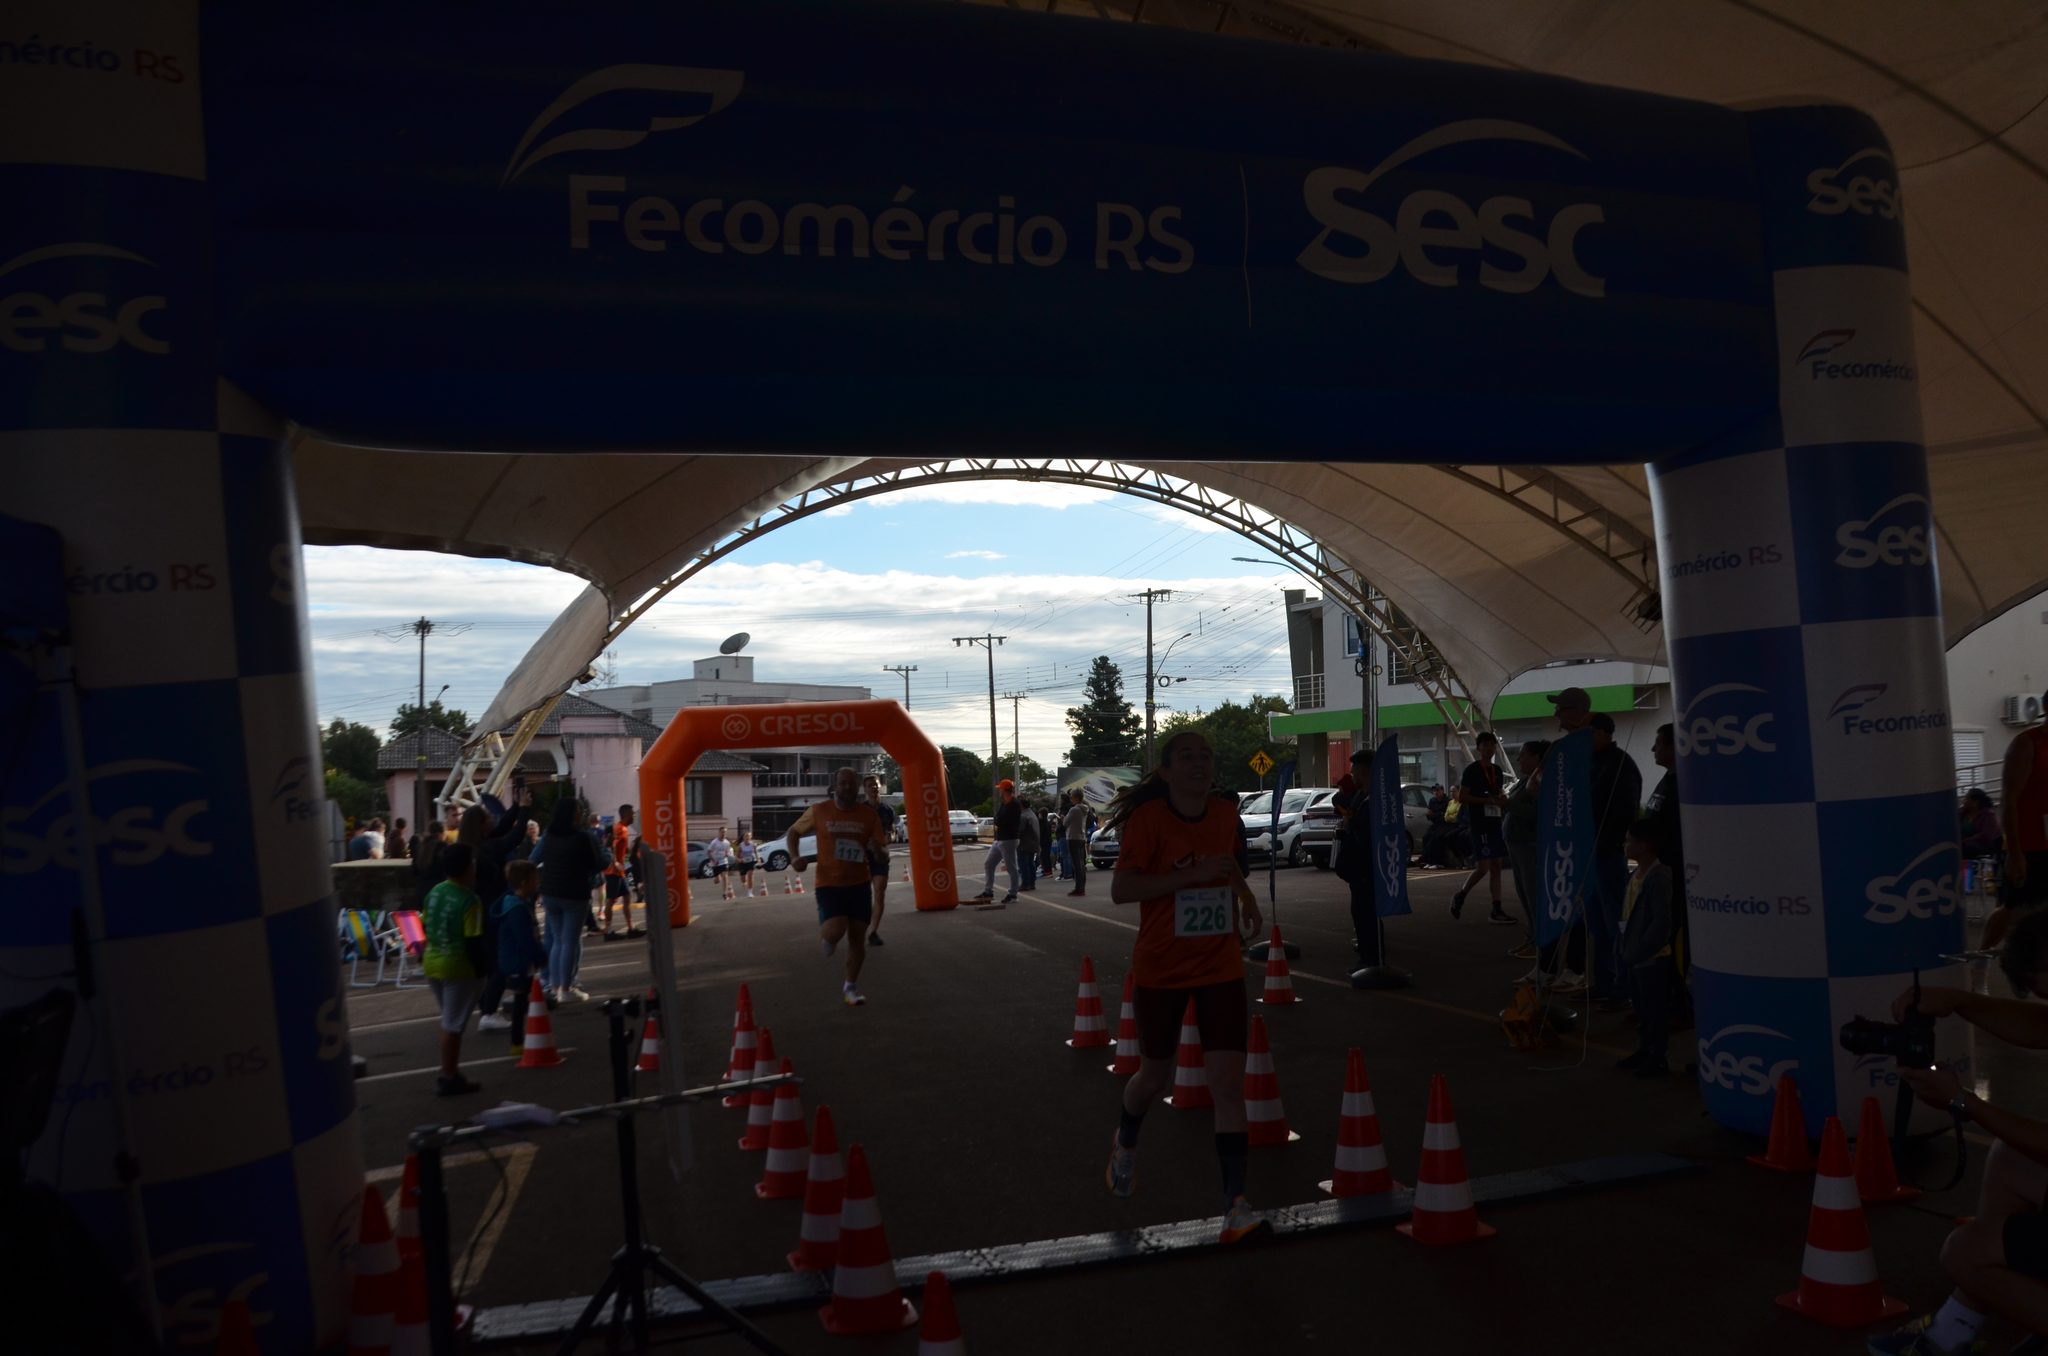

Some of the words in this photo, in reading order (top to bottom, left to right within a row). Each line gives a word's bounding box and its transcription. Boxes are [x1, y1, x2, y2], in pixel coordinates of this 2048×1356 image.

[134, 47, 185, 85] RS
[568, 173, 1068, 267] Fecomércio
[1094, 200, 1196, 274] RS
[1295, 164, 1606, 298] Sesc
[1748, 543, 1783, 567] RS
[169, 563, 217, 591] RS
[760, 711, 865, 737] CRESOL
[923, 776, 945, 861] CRESOL
[1549, 840, 1575, 923] Sesc
[1182, 904, 1227, 933] 226
[1778, 895, 1811, 916] RS
